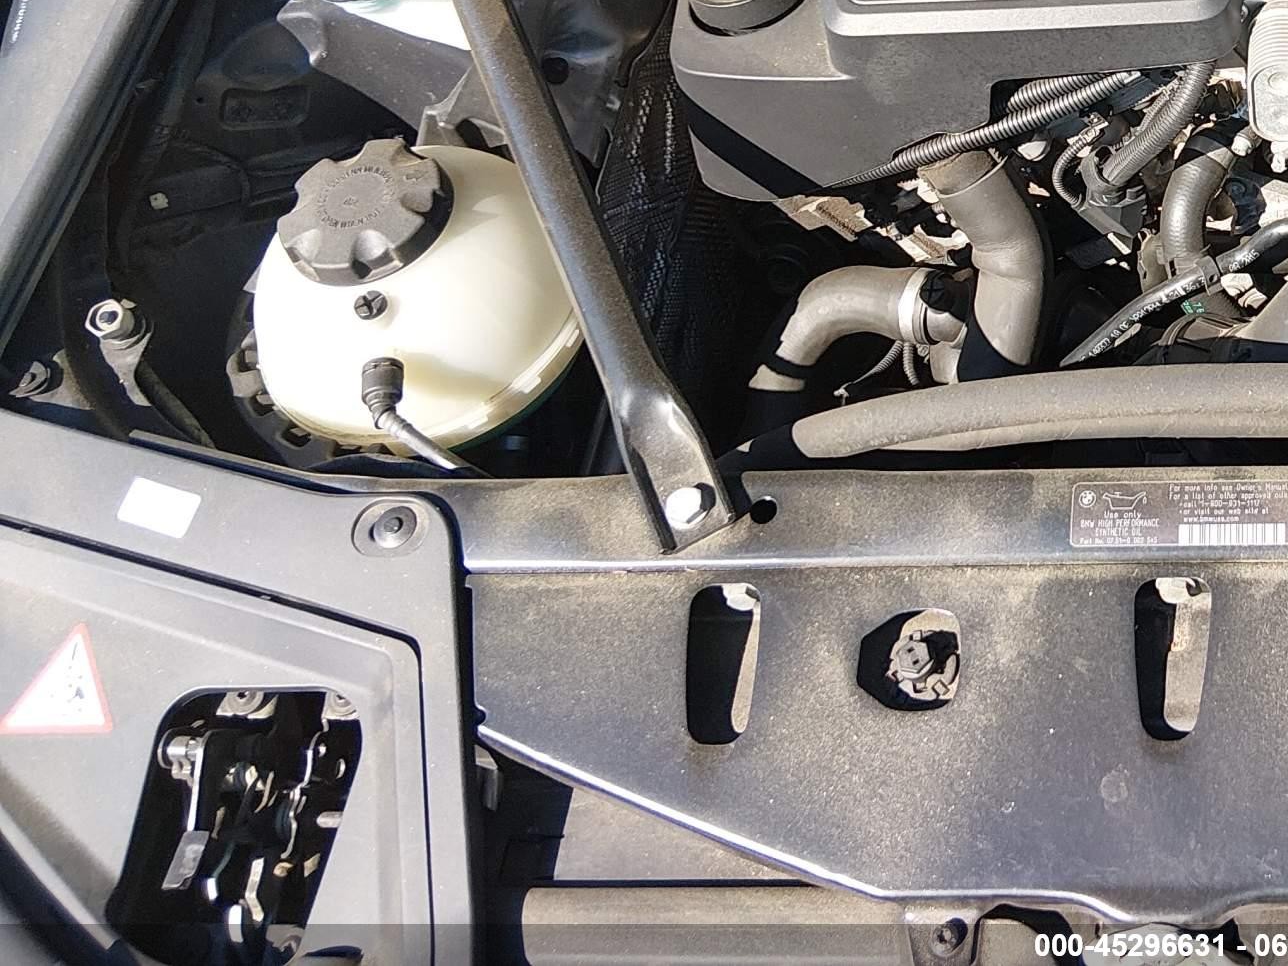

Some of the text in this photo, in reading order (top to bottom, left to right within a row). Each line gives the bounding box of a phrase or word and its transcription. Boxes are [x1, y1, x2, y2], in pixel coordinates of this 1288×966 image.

[1169, 483, 1181, 492] For
[1204, 483, 1218, 491] info
[1192, 492, 1205, 500] list
[1208, 492, 1216, 500] of
[1219, 492, 1238, 500] other
[1240, 492, 1271, 500] approved
[1103, 509, 1142, 521] Use only
[1194, 507, 1211, 515] visit
[1228, 507, 1242, 515] web
[1080, 517, 1160, 528] BMW HIGH PERFORMANCE
[1183, 515, 1240, 523] www.bmwusa.com
[1095, 527, 1142, 537] SYNTHETIC OIL
